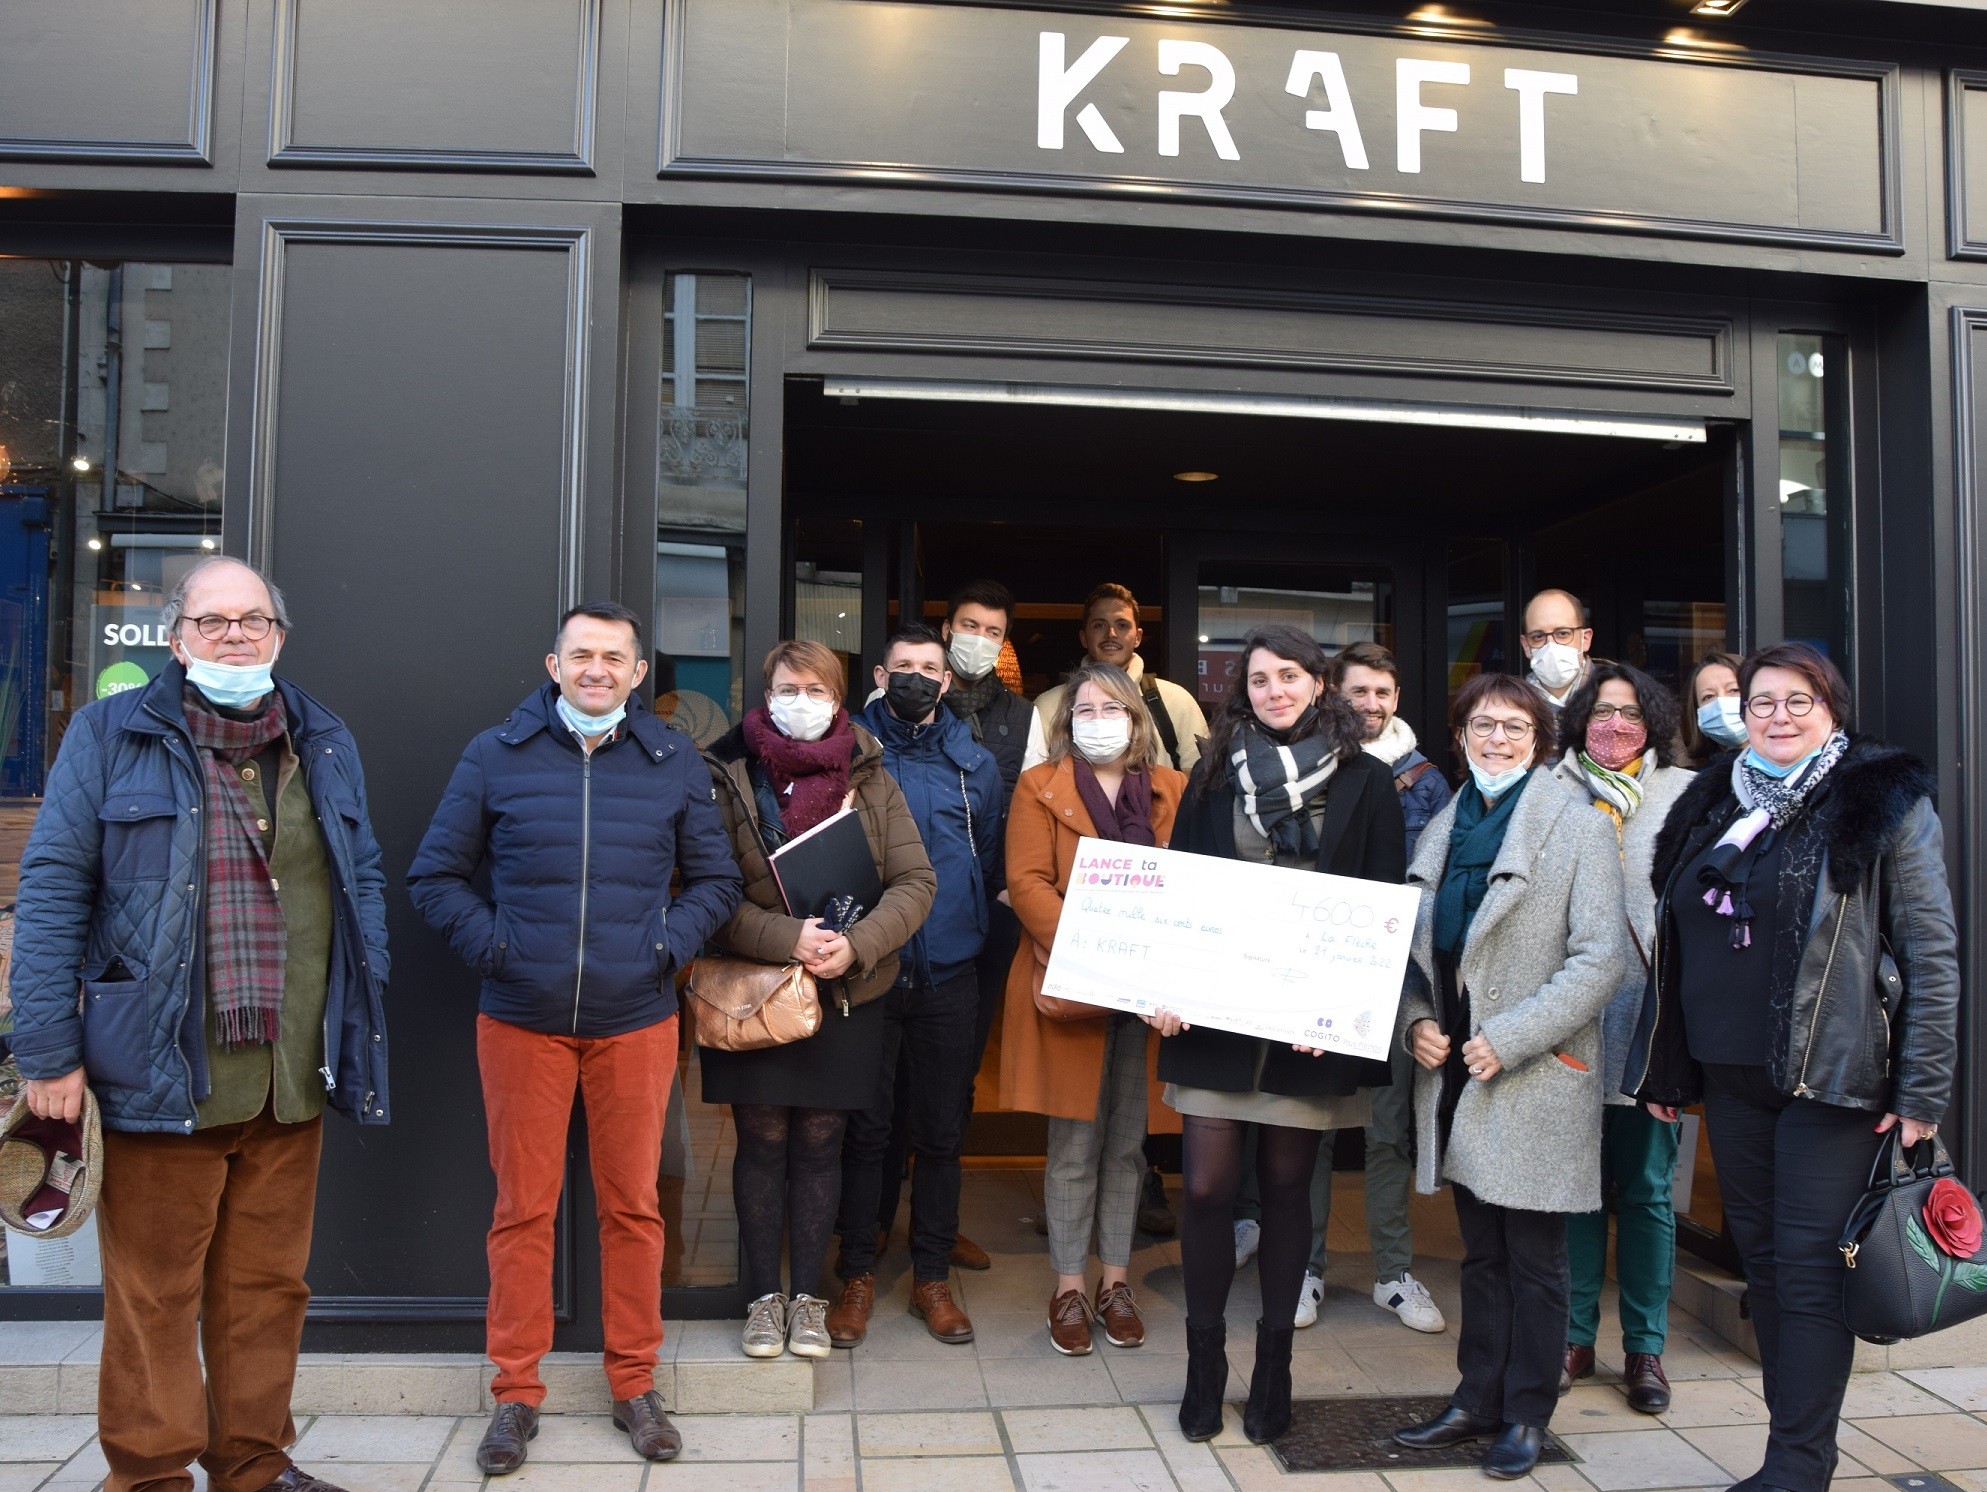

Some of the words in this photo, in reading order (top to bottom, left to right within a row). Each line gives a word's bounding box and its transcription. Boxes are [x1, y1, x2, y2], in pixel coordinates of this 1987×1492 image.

[1038, 32, 1578, 184] KRAFT
[1079, 857, 1133, 870] LANCE
[1141, 859, 1158, 871] ta
[1075, 872, 1165, 888] BOUTIQUE
[1291, 890, 1375, 929] 4600
[1384, 917, 1400, 934] €
[1096, 936, 1152, 960] KRAFT
[1314, 945, 1328, 957] 21
[1369, 955, 1393, 969] 2022
[1304, 1029, 1340, 1042] COGITO
